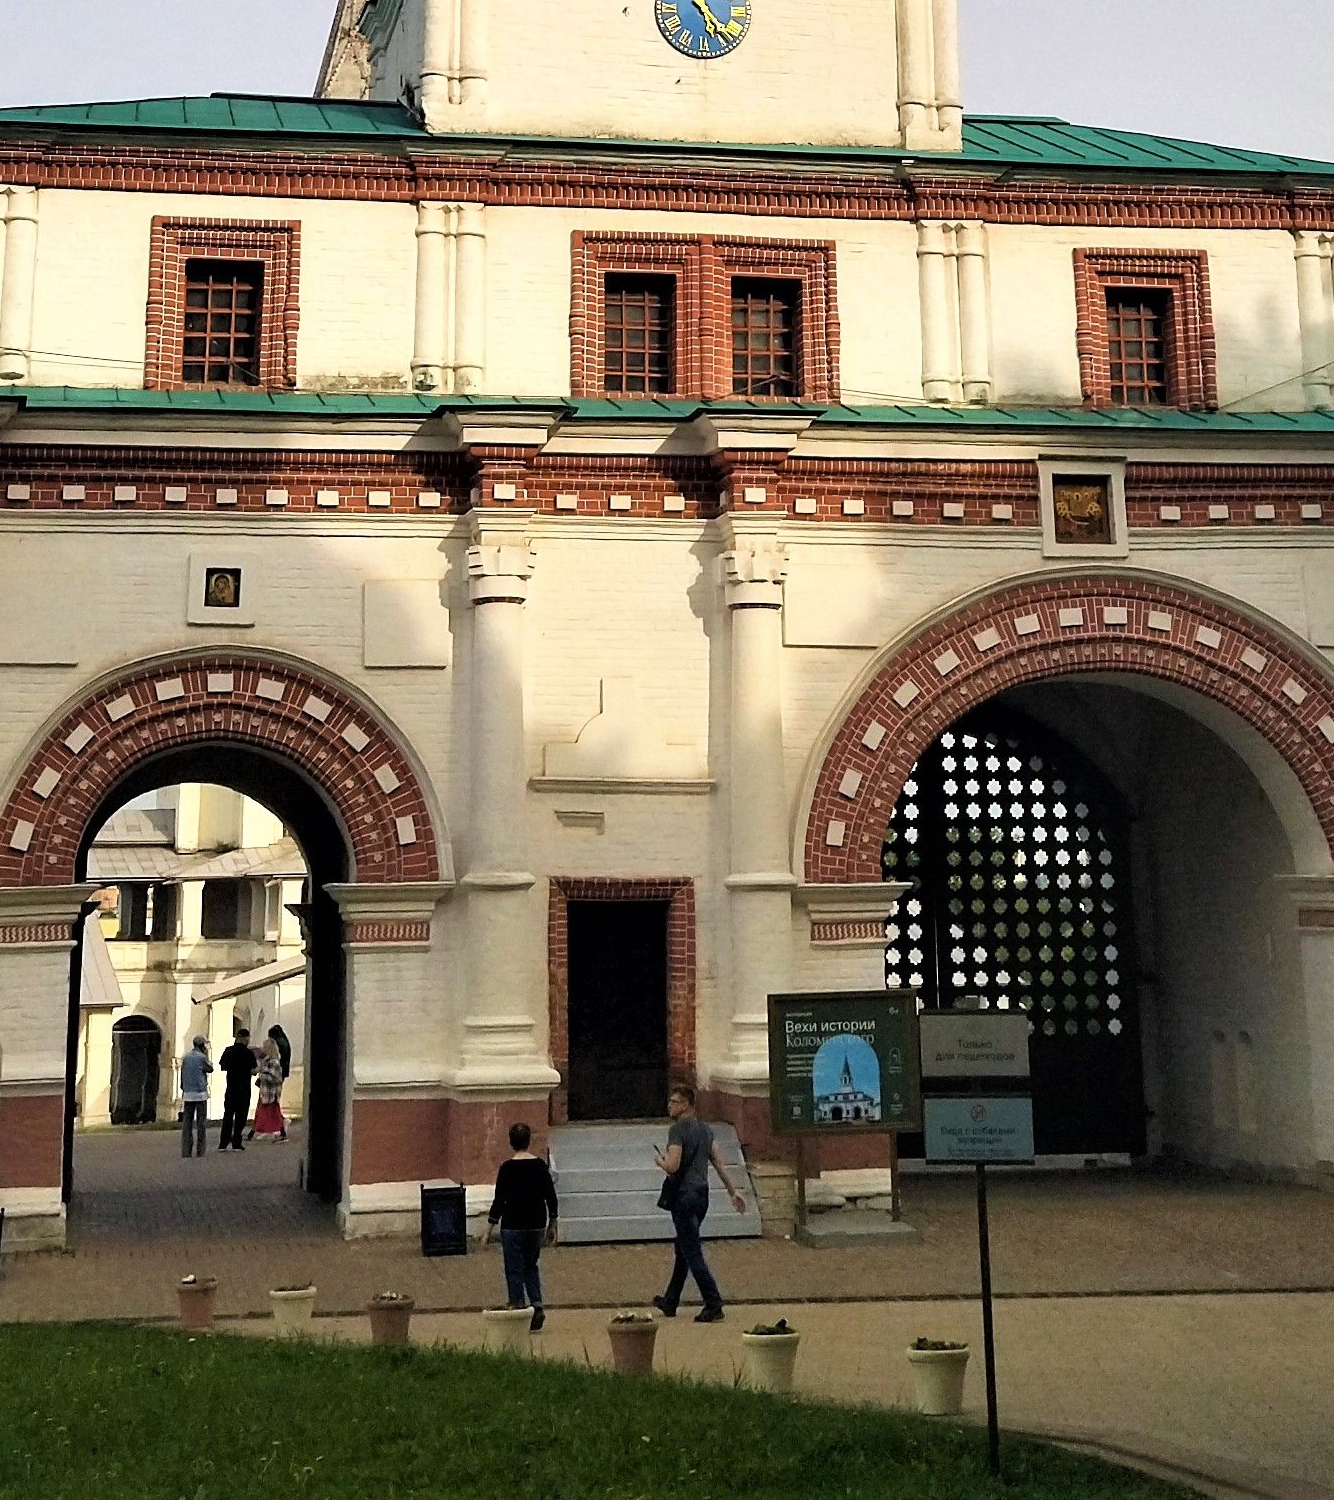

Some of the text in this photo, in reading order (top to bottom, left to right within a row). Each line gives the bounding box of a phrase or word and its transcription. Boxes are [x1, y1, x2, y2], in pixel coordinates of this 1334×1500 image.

[785, 1019, 876, 1034] Вехи истории
[786, 1033, 875, 1048] Коломго
